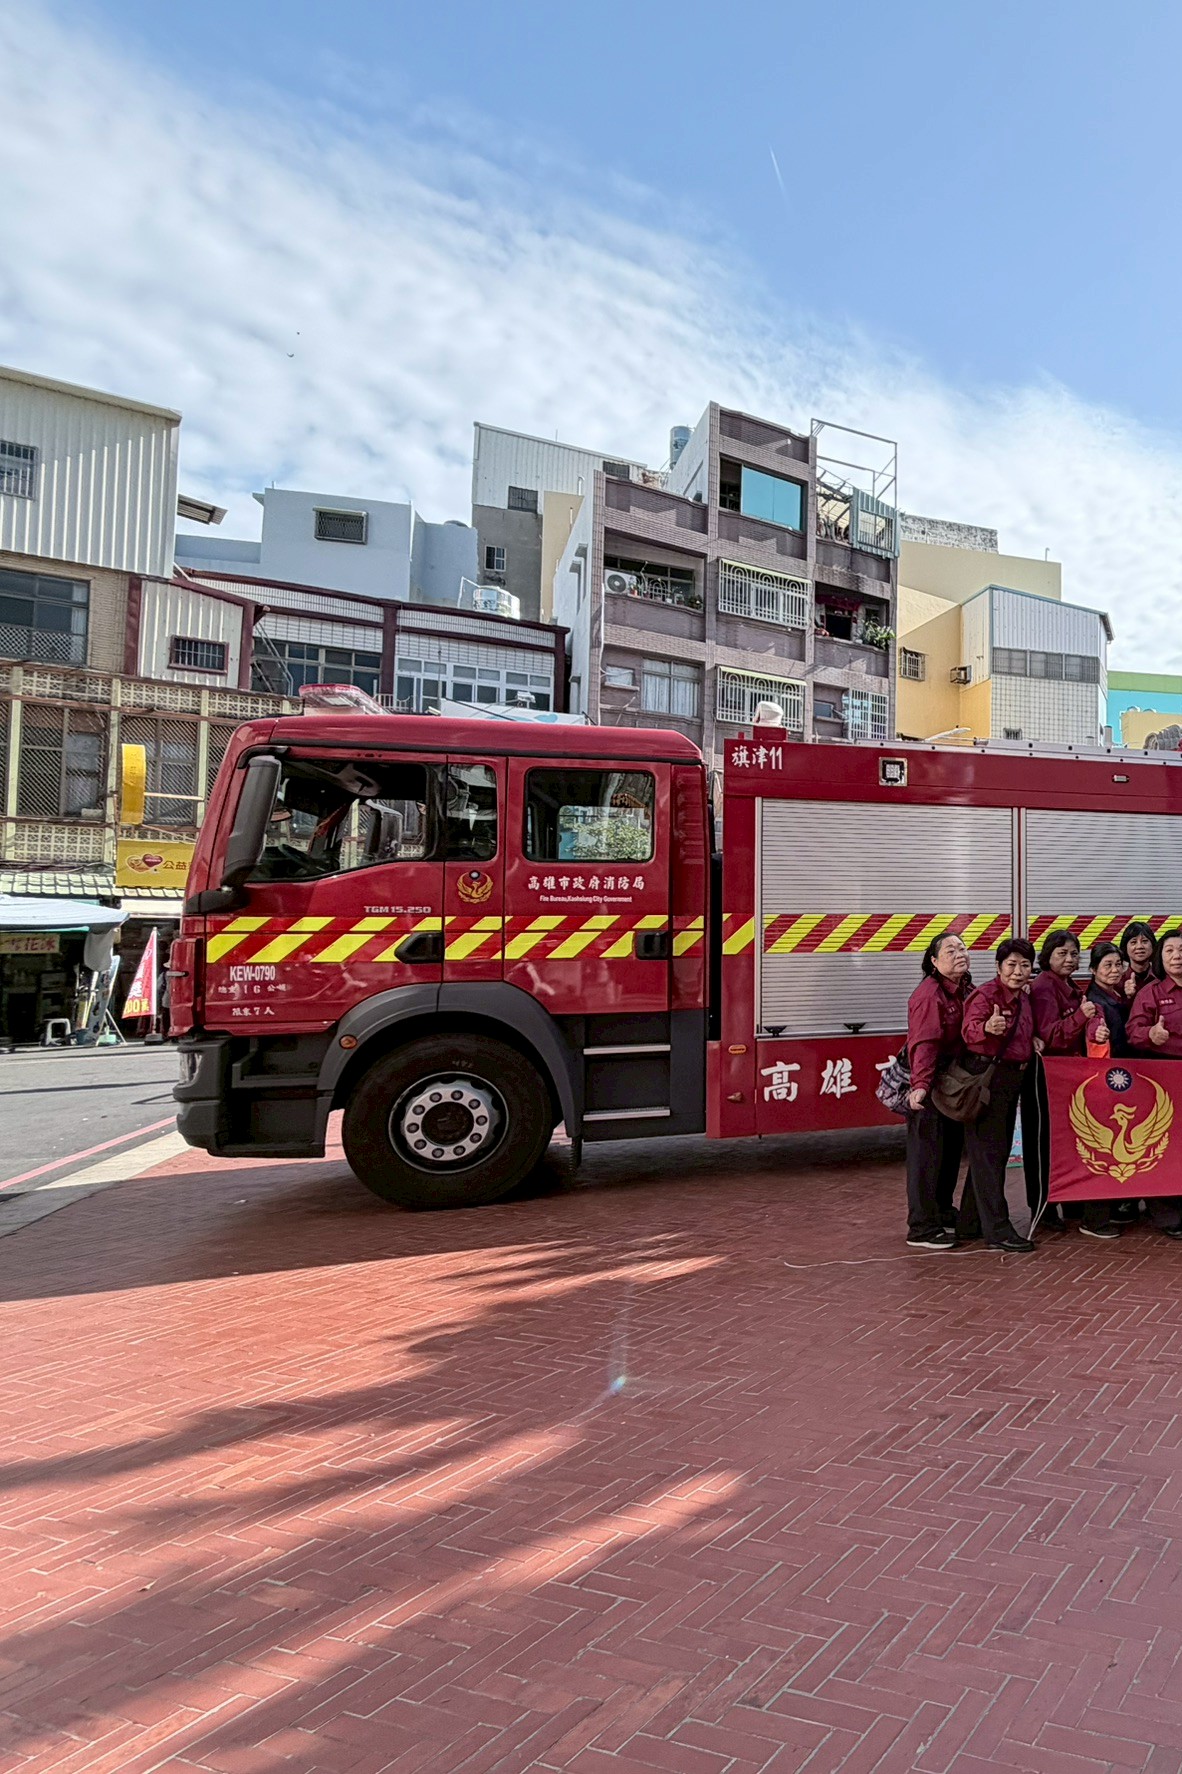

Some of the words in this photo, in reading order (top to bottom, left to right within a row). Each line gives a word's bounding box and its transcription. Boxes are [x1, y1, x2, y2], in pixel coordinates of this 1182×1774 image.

[731, 745, 783, 770] 旗津11
[162, 859, 192, 871] 公益
[527, 875, 645, 890] 高雄市政府消防局
[603, 895, 632, 903] Government
[229, 965, 276, 981] KEW-0790
[760, 1055, 898, 1102] 高雄
